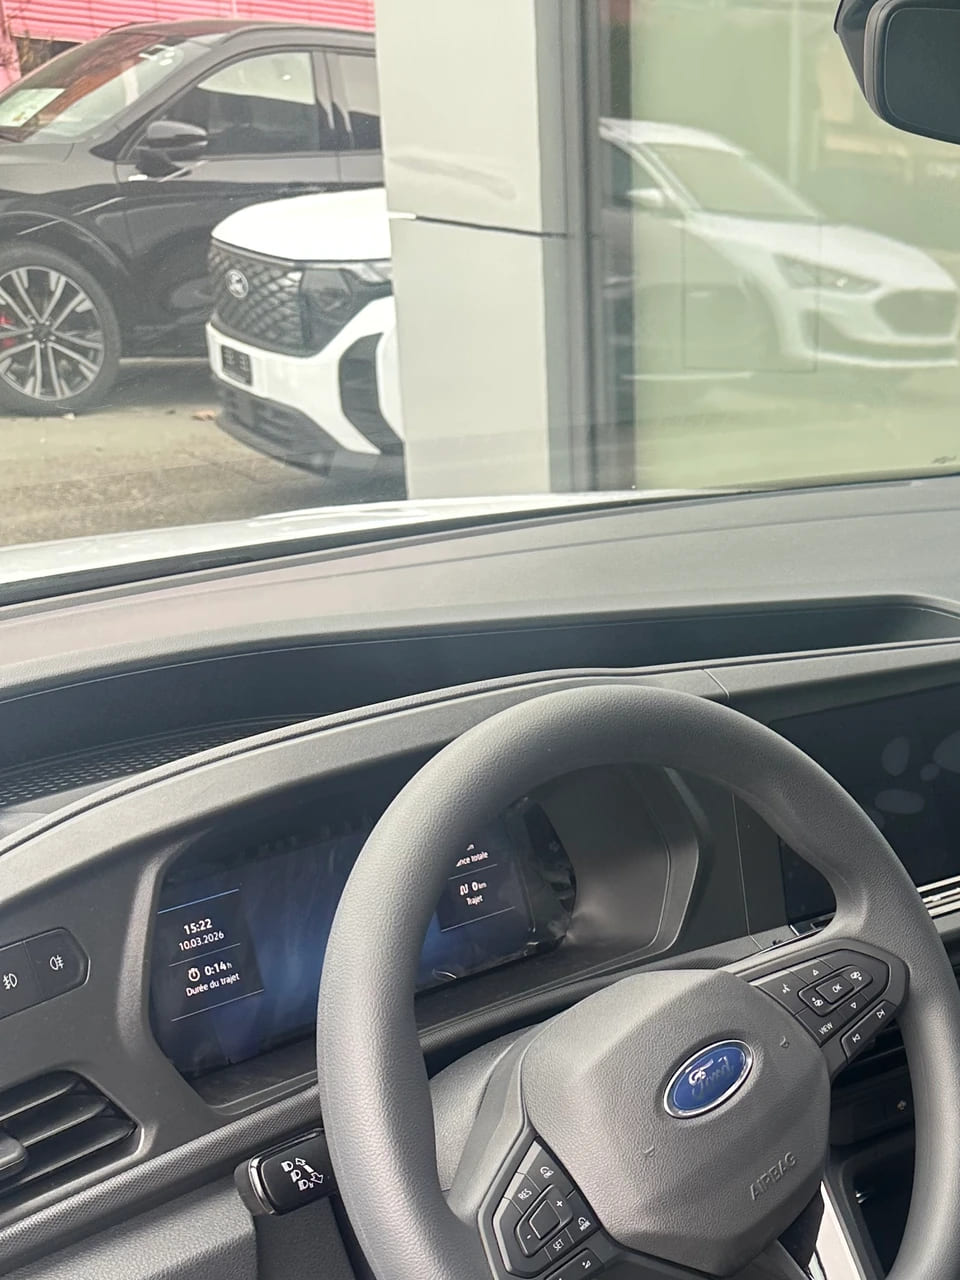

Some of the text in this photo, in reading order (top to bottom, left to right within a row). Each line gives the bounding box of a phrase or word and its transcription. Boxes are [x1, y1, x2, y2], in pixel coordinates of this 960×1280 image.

[466, 895, 483, 905] Trajet
[184, 918, 212, 935] 15:22
[179, 931, 225, 951] 10.03.2026
[186, 973, 240, 996] Durée du trajet
[832, 983, 843, 993] OK
[818, 1021, 834, 1035] VIEW
[518, 1188, 532, 1201] RES
[552, 1239, 565, 1251] SET
